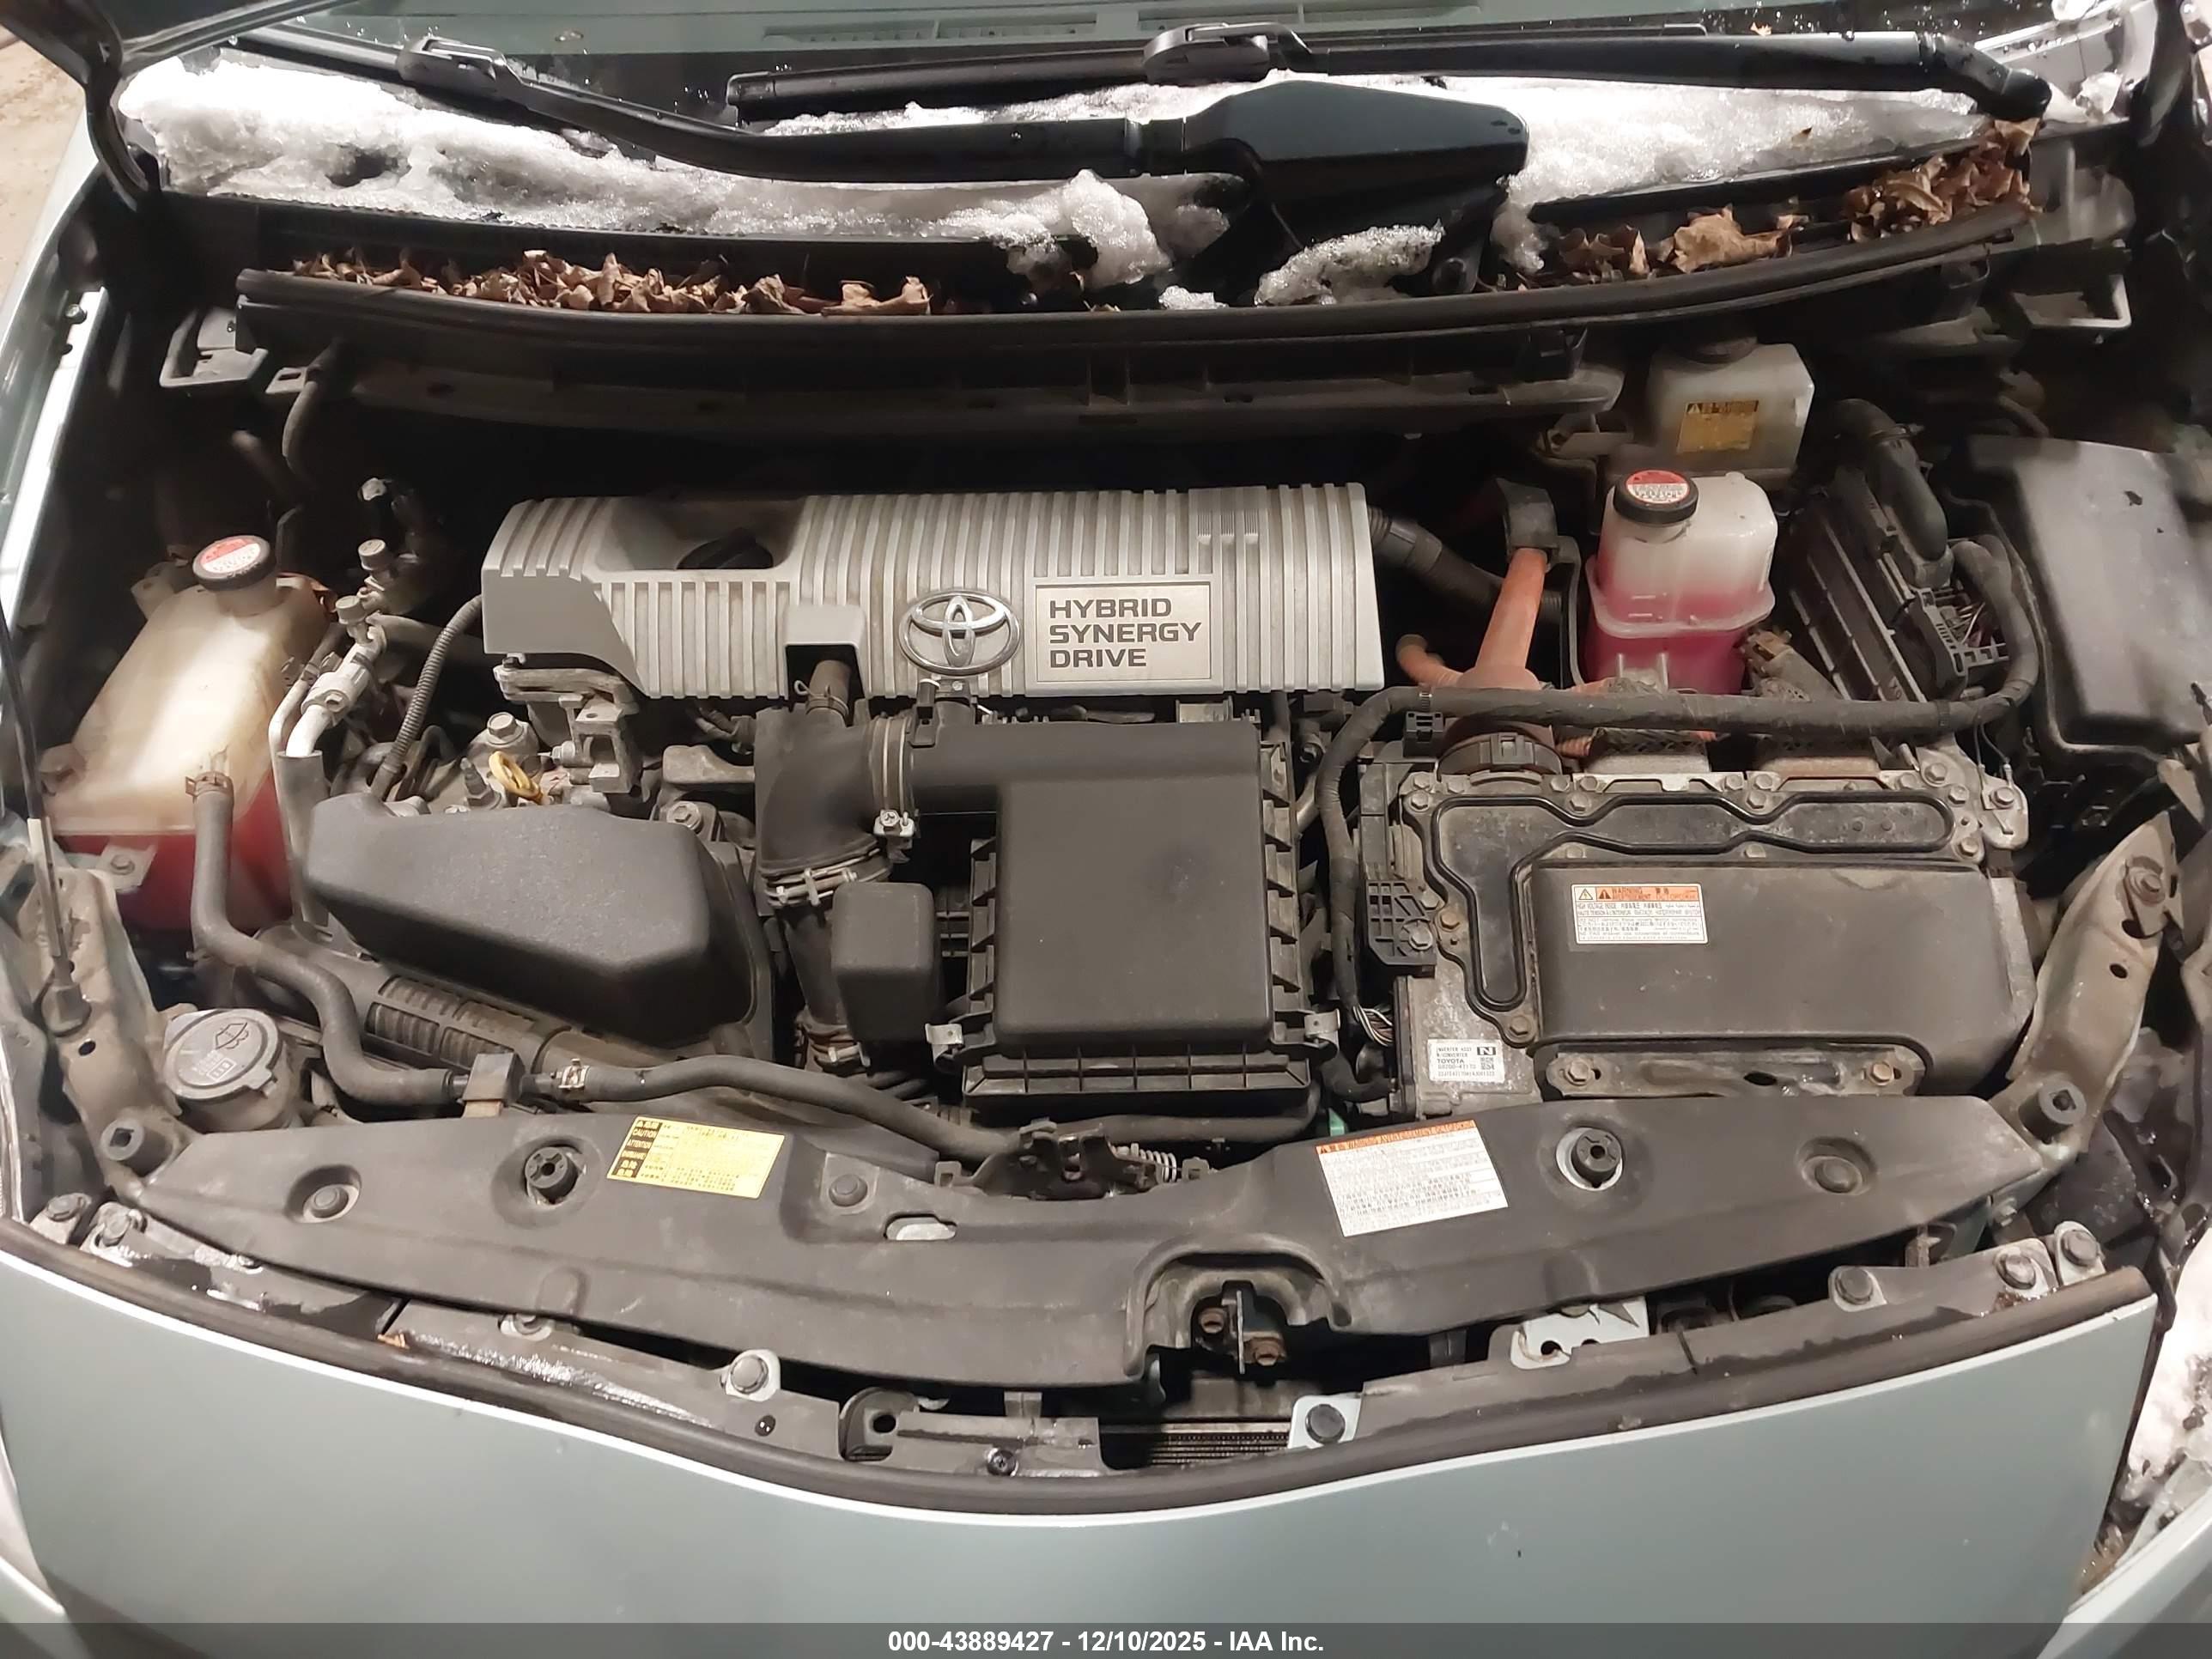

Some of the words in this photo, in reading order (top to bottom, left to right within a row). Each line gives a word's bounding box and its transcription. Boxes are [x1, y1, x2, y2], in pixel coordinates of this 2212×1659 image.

[1049, 598, 1171, 619] HYBRID
[1049, 623, 1202, 644] SYNERGY
[1049, 648, 1147, 668] DRIVE
[632, 1128, 658, 1139] CAUTION
